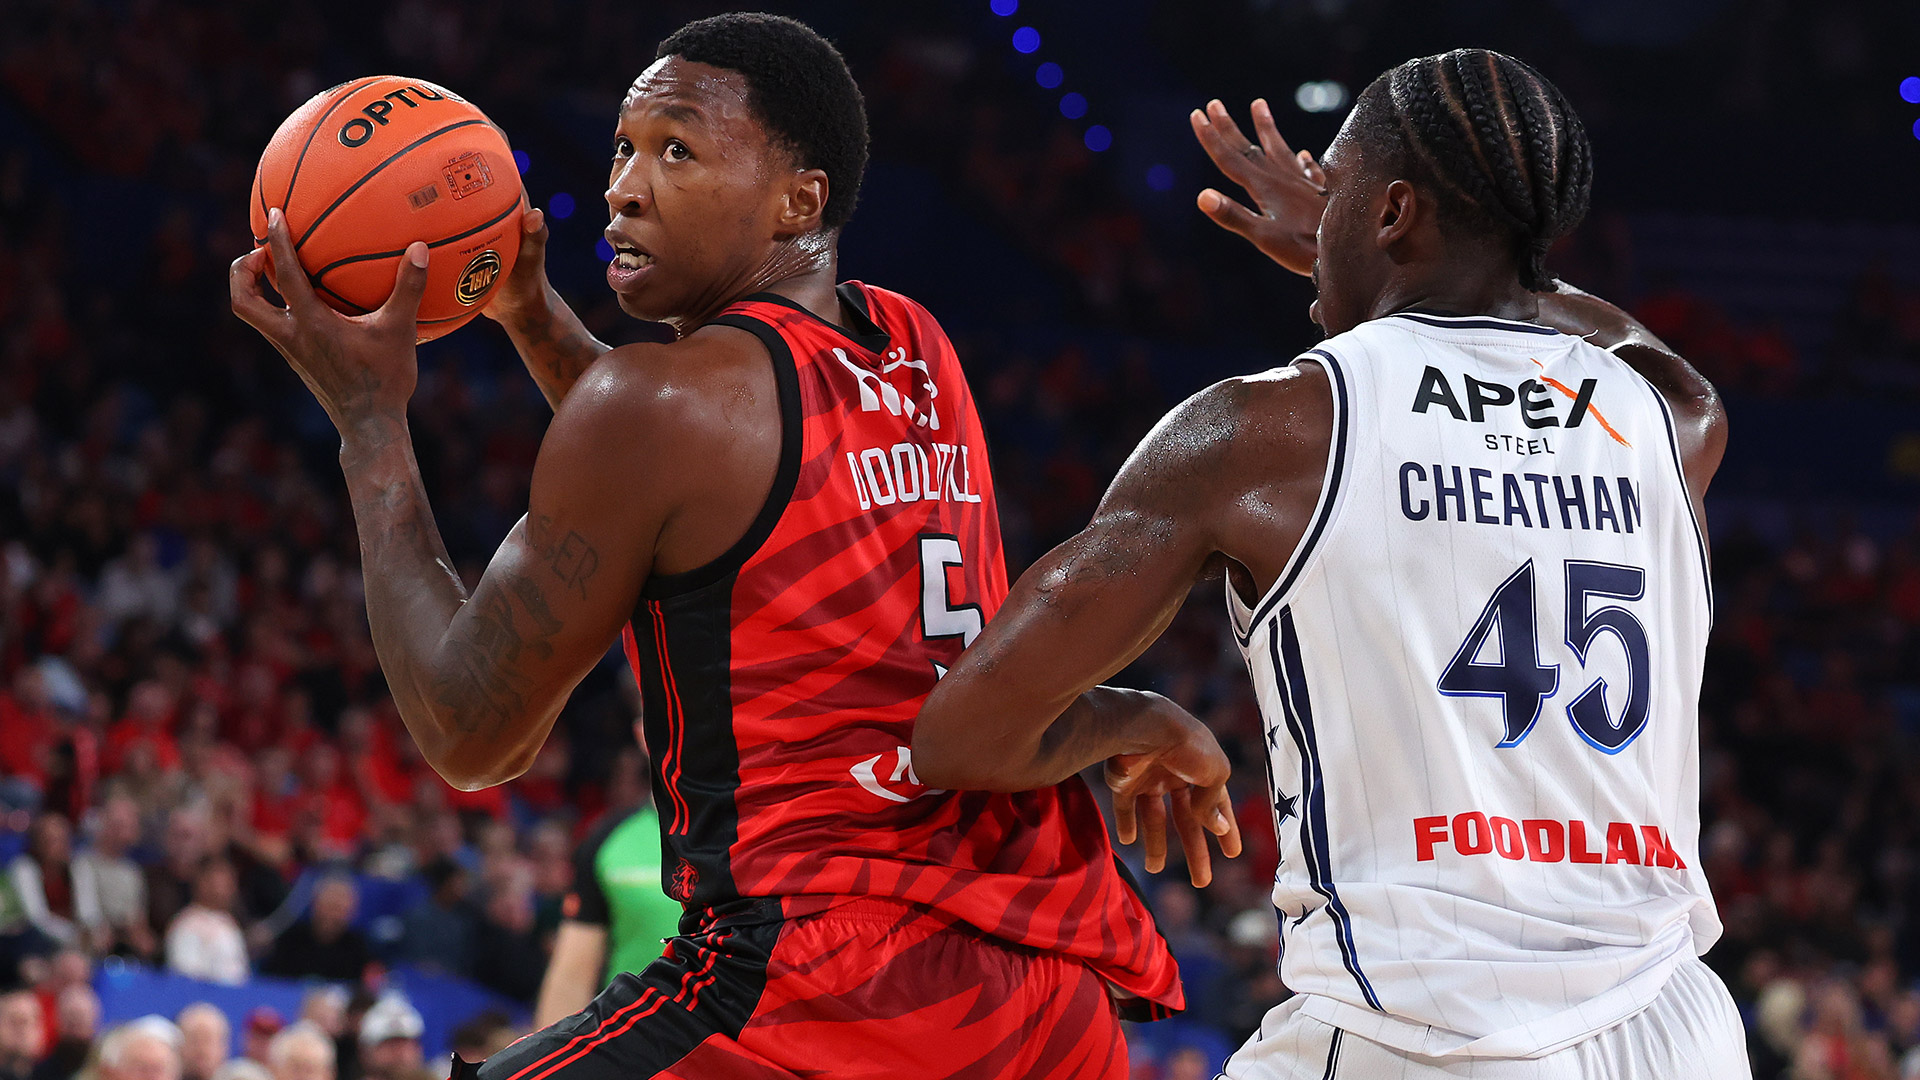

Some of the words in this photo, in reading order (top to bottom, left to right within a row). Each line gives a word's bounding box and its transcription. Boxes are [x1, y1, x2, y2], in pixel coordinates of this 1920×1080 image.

[469, 266, 493, 292] NBL
[1412, 358, 1632, 449] APEX
[1485, 434, 1555, 455] STEEL
[917, 533, 986, 683] 5
[1437, 556, 1651, 756] 45
[1413, 810, 1687, 870] FOODLAN
